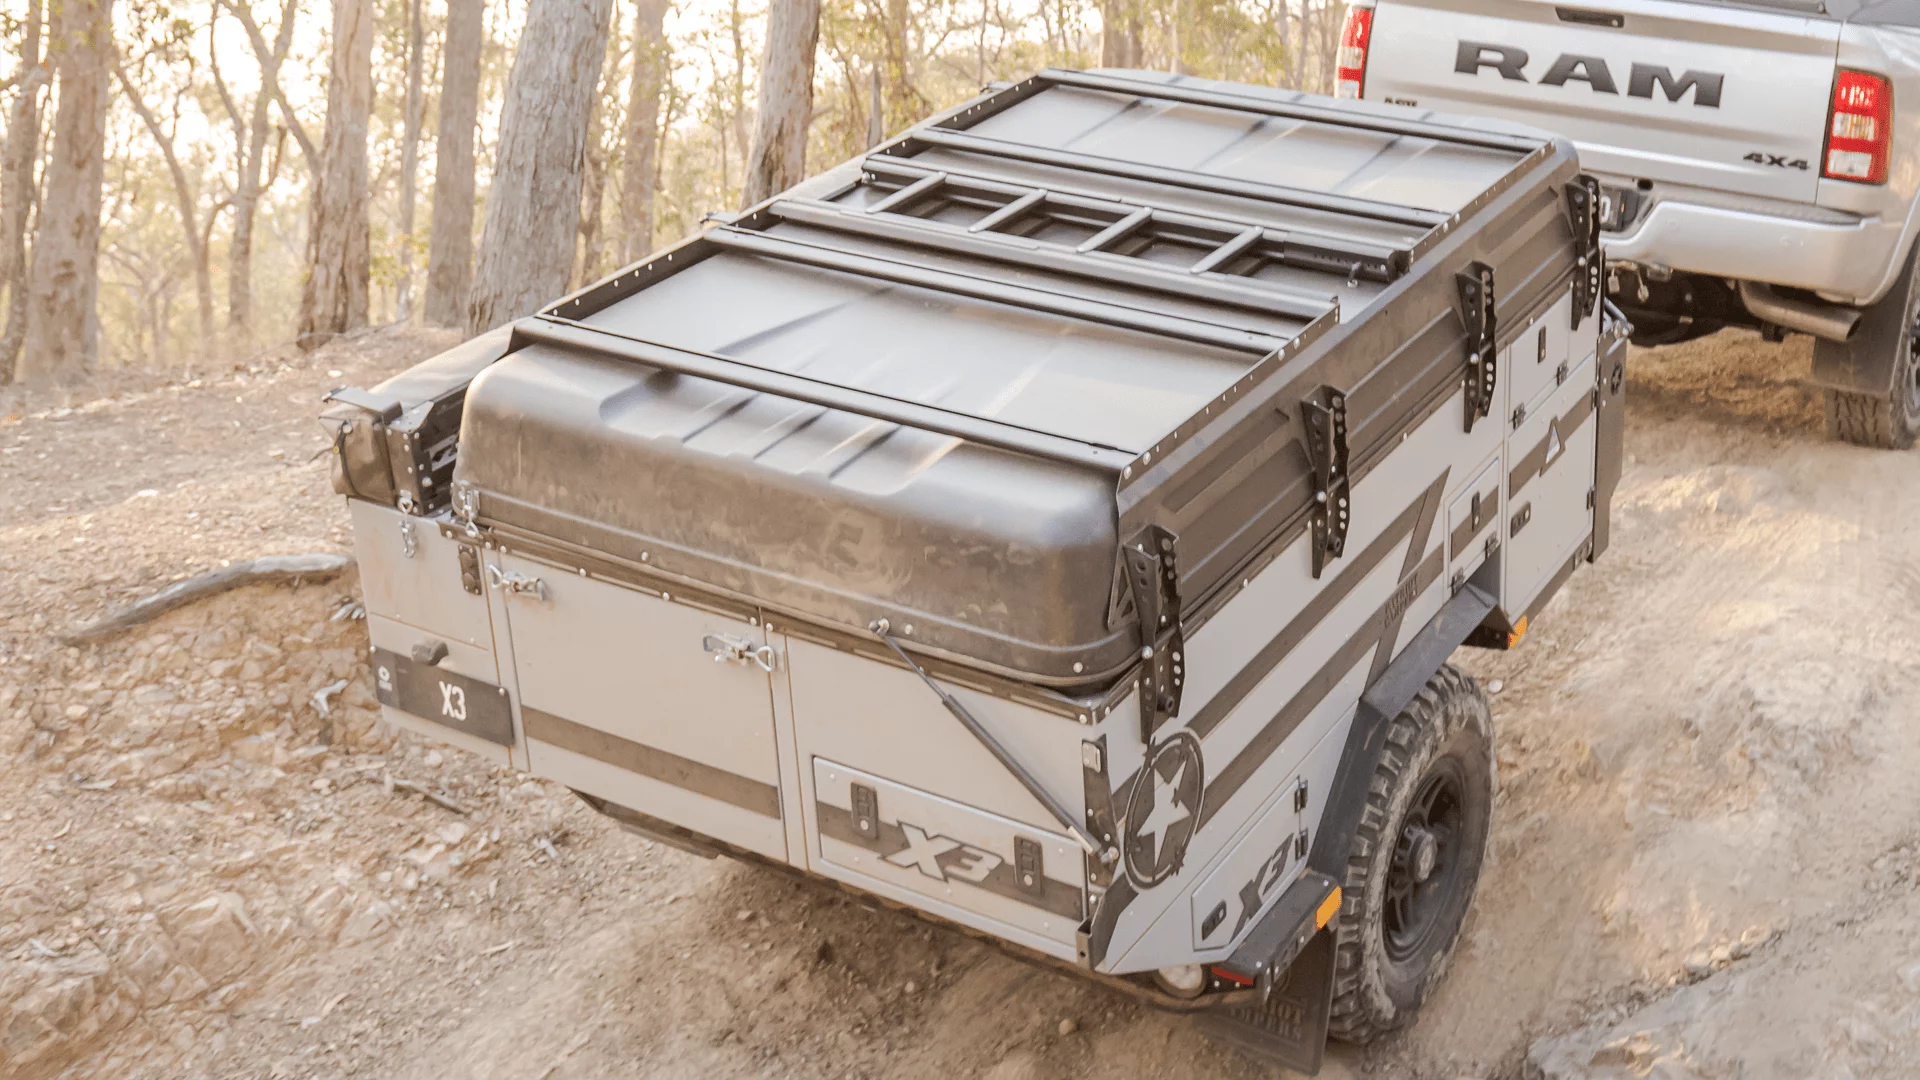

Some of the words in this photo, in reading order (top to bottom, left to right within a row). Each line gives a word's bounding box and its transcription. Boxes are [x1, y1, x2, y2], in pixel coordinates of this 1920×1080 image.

[1454, 39, 1725, 108] RAM
[438, 680, 466, 721] X3
[880, 820, 1004, 883] X3
[1228, 832, 1294, 945] X3
